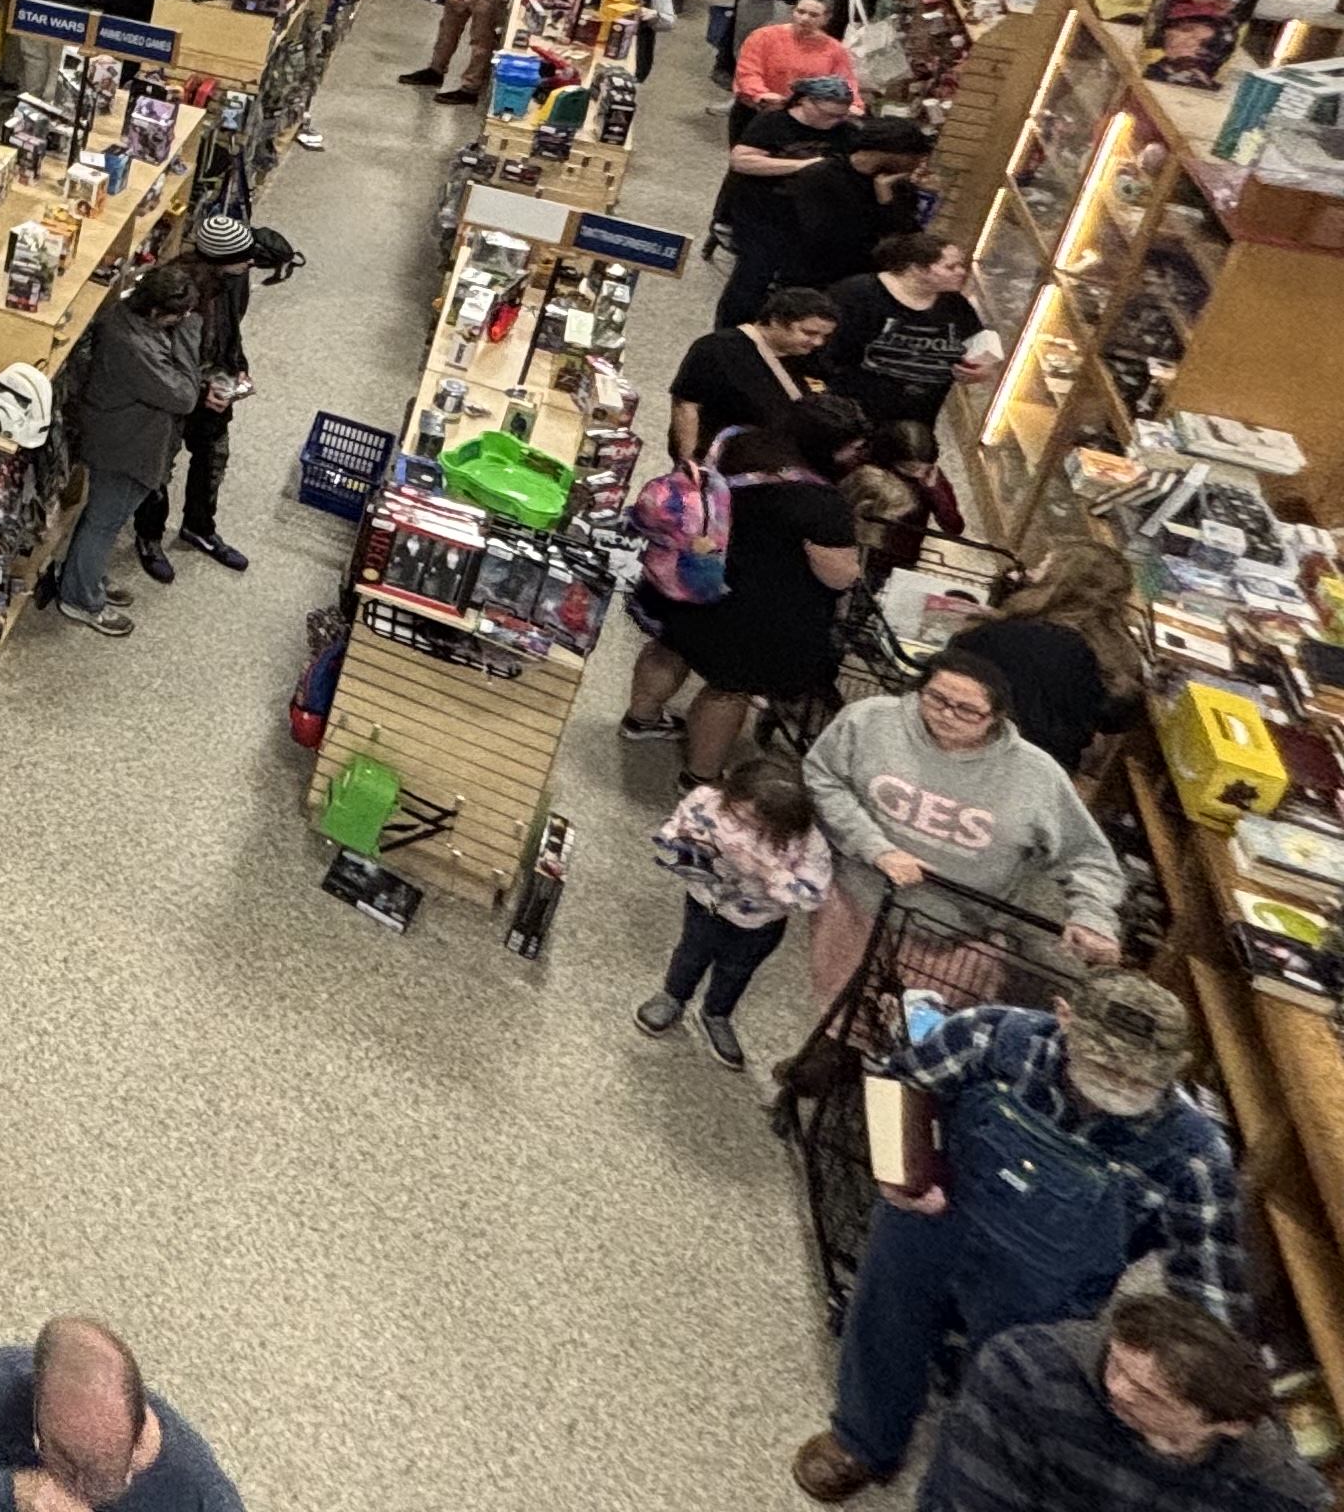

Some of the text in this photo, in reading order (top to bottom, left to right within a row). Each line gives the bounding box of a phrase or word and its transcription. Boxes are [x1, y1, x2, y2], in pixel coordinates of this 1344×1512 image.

[17, 8, 86, 34] STAR WARS
[868, 774, 994, 849] GES
